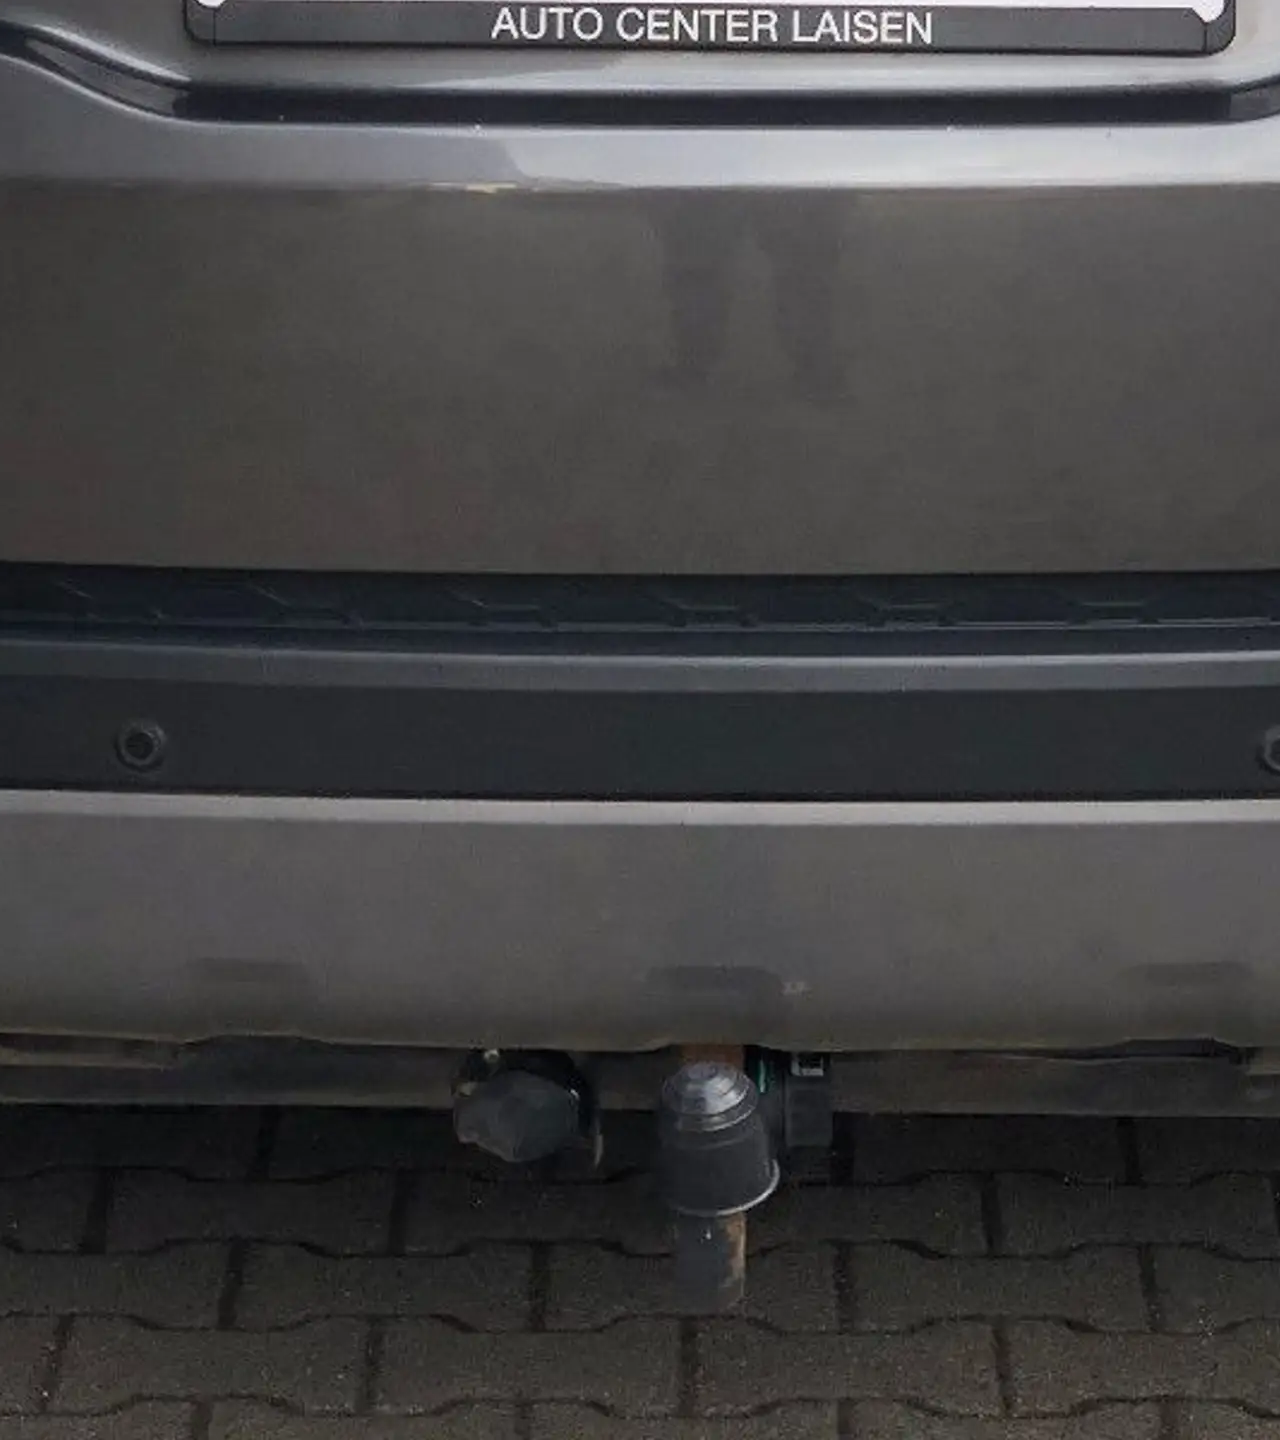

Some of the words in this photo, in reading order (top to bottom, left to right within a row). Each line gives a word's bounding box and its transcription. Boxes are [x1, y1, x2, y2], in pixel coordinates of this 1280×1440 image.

[490, 6, 604, 42] AUTO
[615, 8, 779, 44] CENTER
[791, 10, 934, 45] LAISEN
